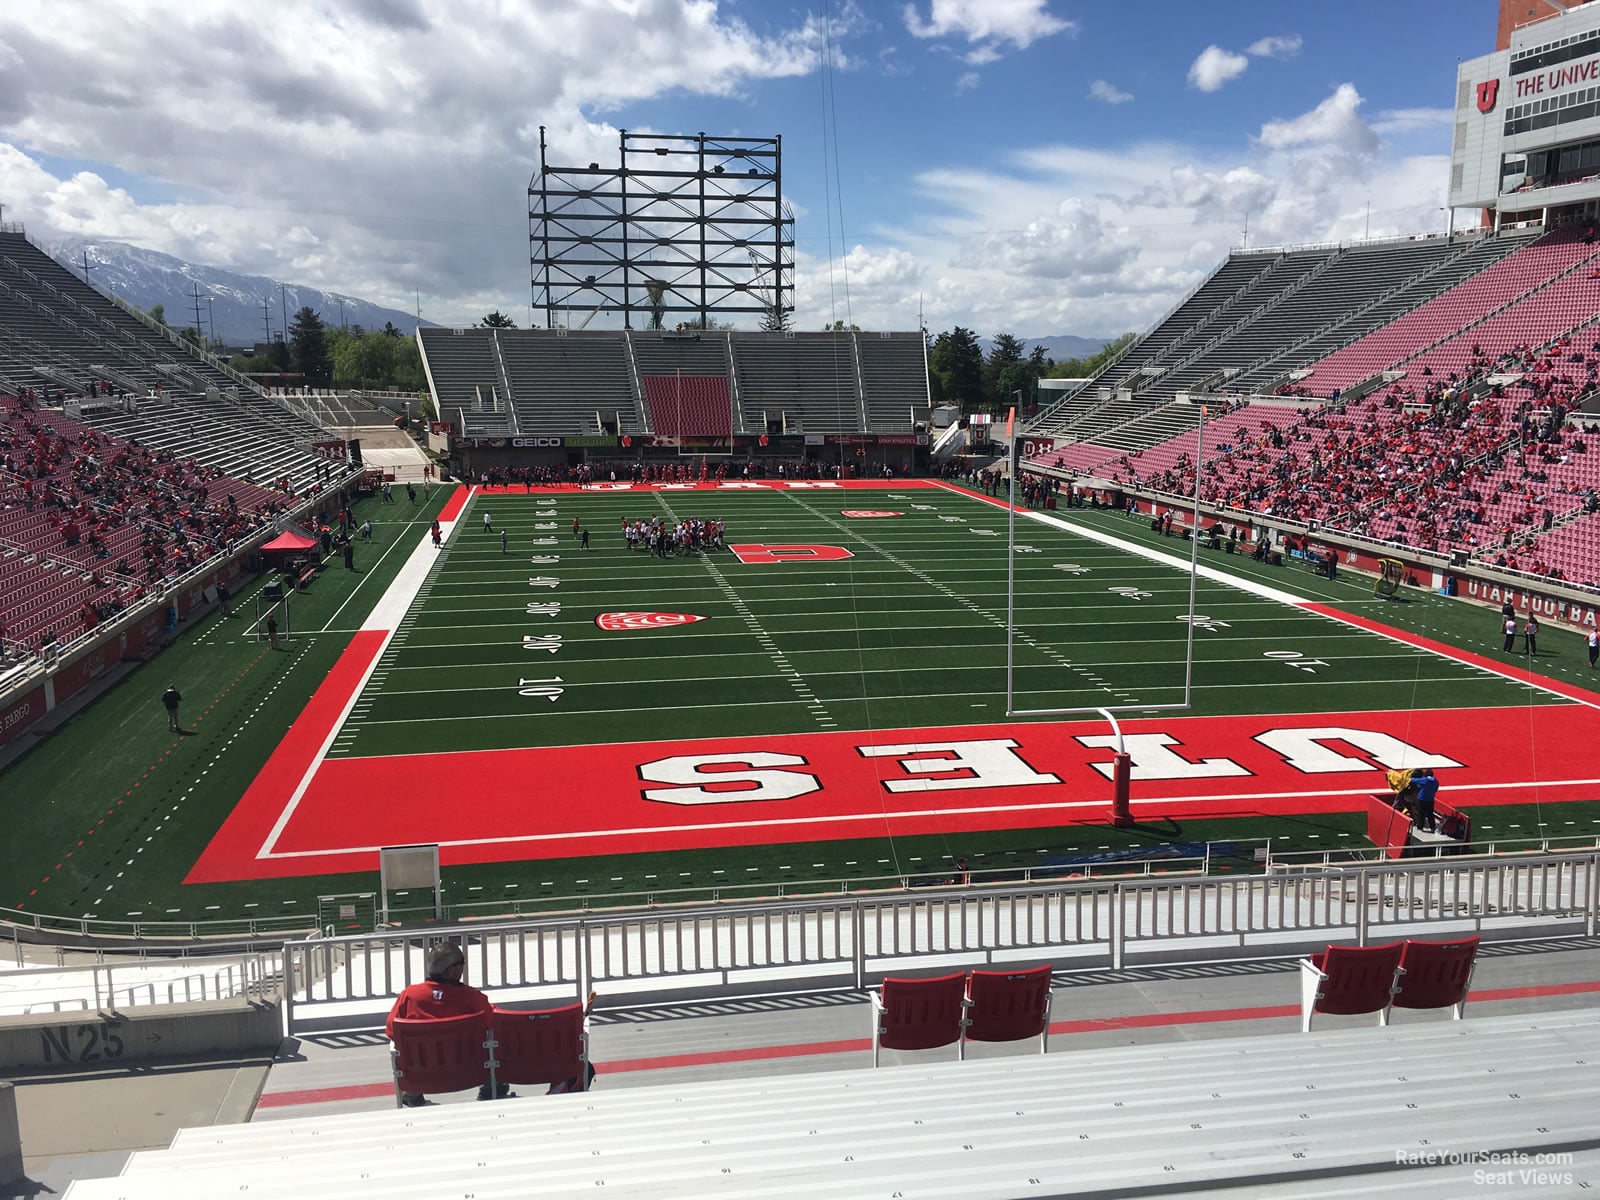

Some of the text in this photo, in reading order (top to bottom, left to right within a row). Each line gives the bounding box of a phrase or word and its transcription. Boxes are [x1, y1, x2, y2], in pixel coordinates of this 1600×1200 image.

[1476, 78, 1499, 113] U
[1516, 74, 1544, 98] THE
[512, 437, 561, 447] GEICO
[728, 543, 855, 564] U
[1468, 579, 1514, 605] UTAH
[526, 602, 561, 615] 30
[522, 634, 563, 650] 20
[1263, 651, 1331, 668] 10
[518, 676, 565, 696] 10
[5, 703, 30, 730] FARGO
[640, 726, 1468, 806] UTES
[41, 1022, 124, 1063] N25
